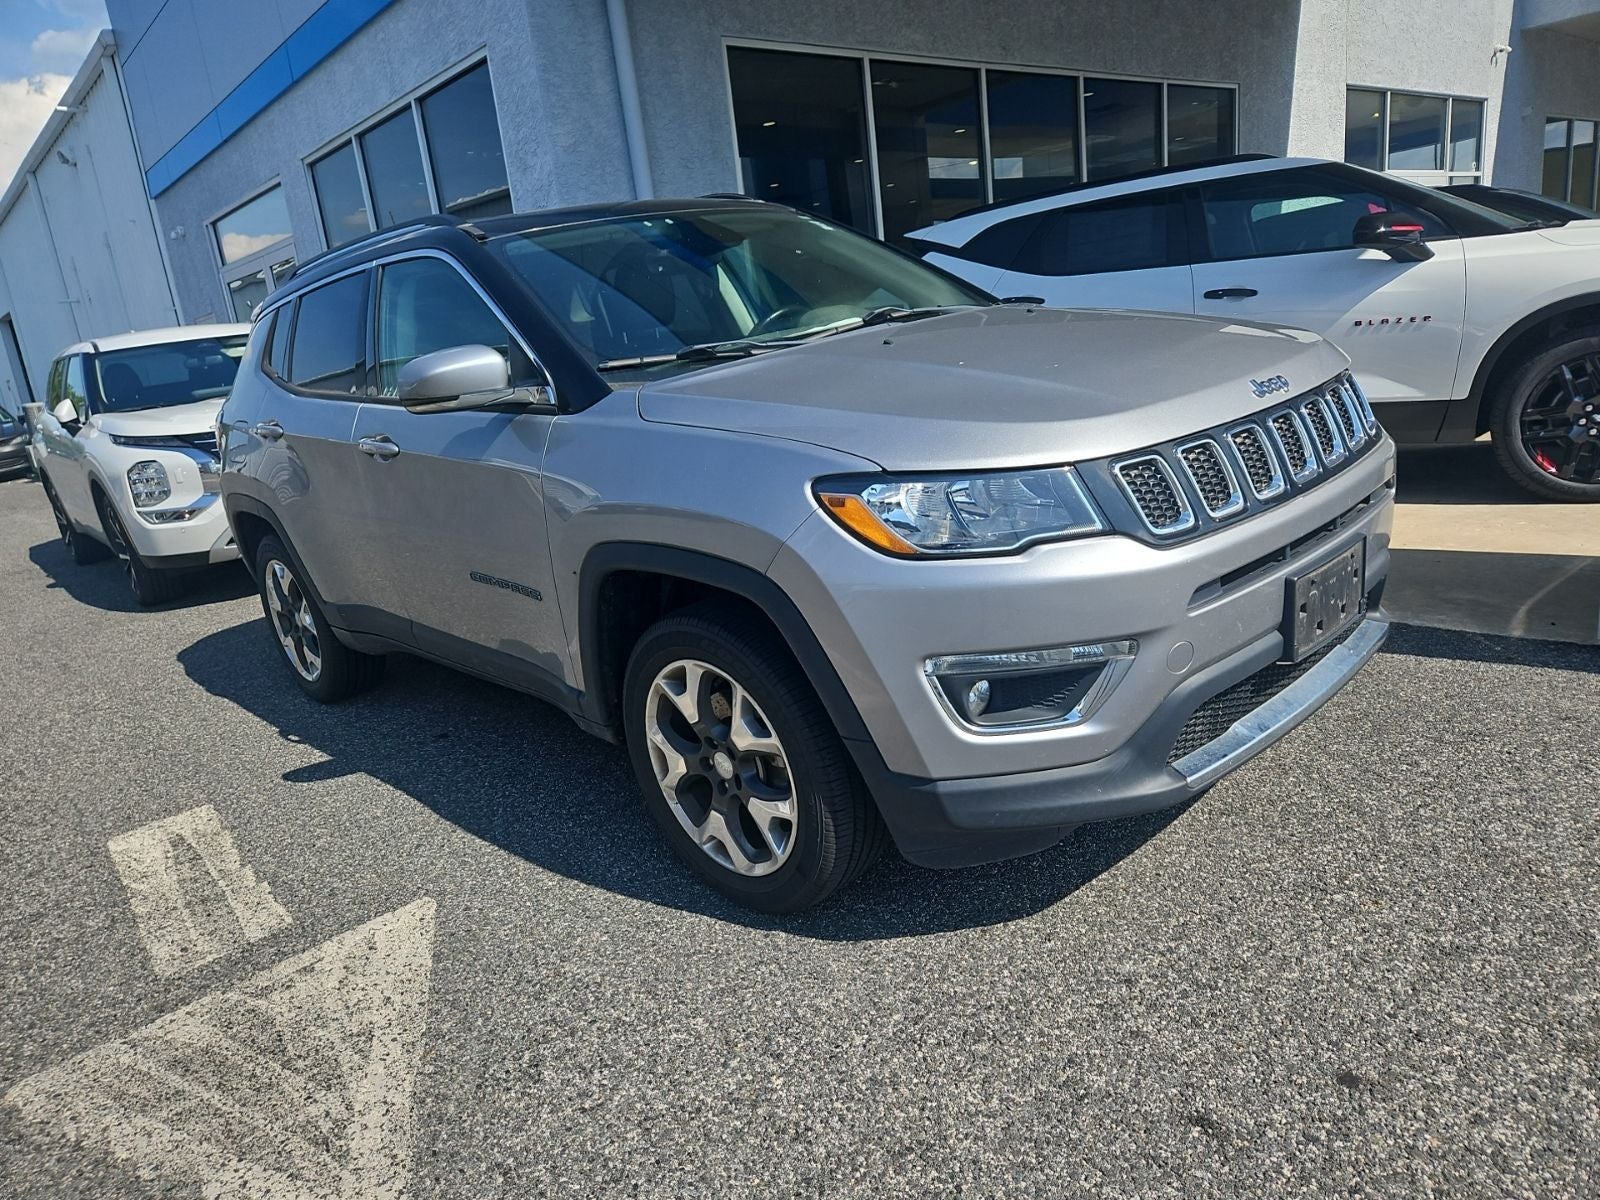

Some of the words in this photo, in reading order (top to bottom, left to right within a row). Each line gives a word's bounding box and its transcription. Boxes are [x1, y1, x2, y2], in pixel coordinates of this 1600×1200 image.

[1354, 315, 1432, 327] BLAZER
[1249, 375, 1290, 398] Jeep
[469, 570, 543, 601] COMPASS
